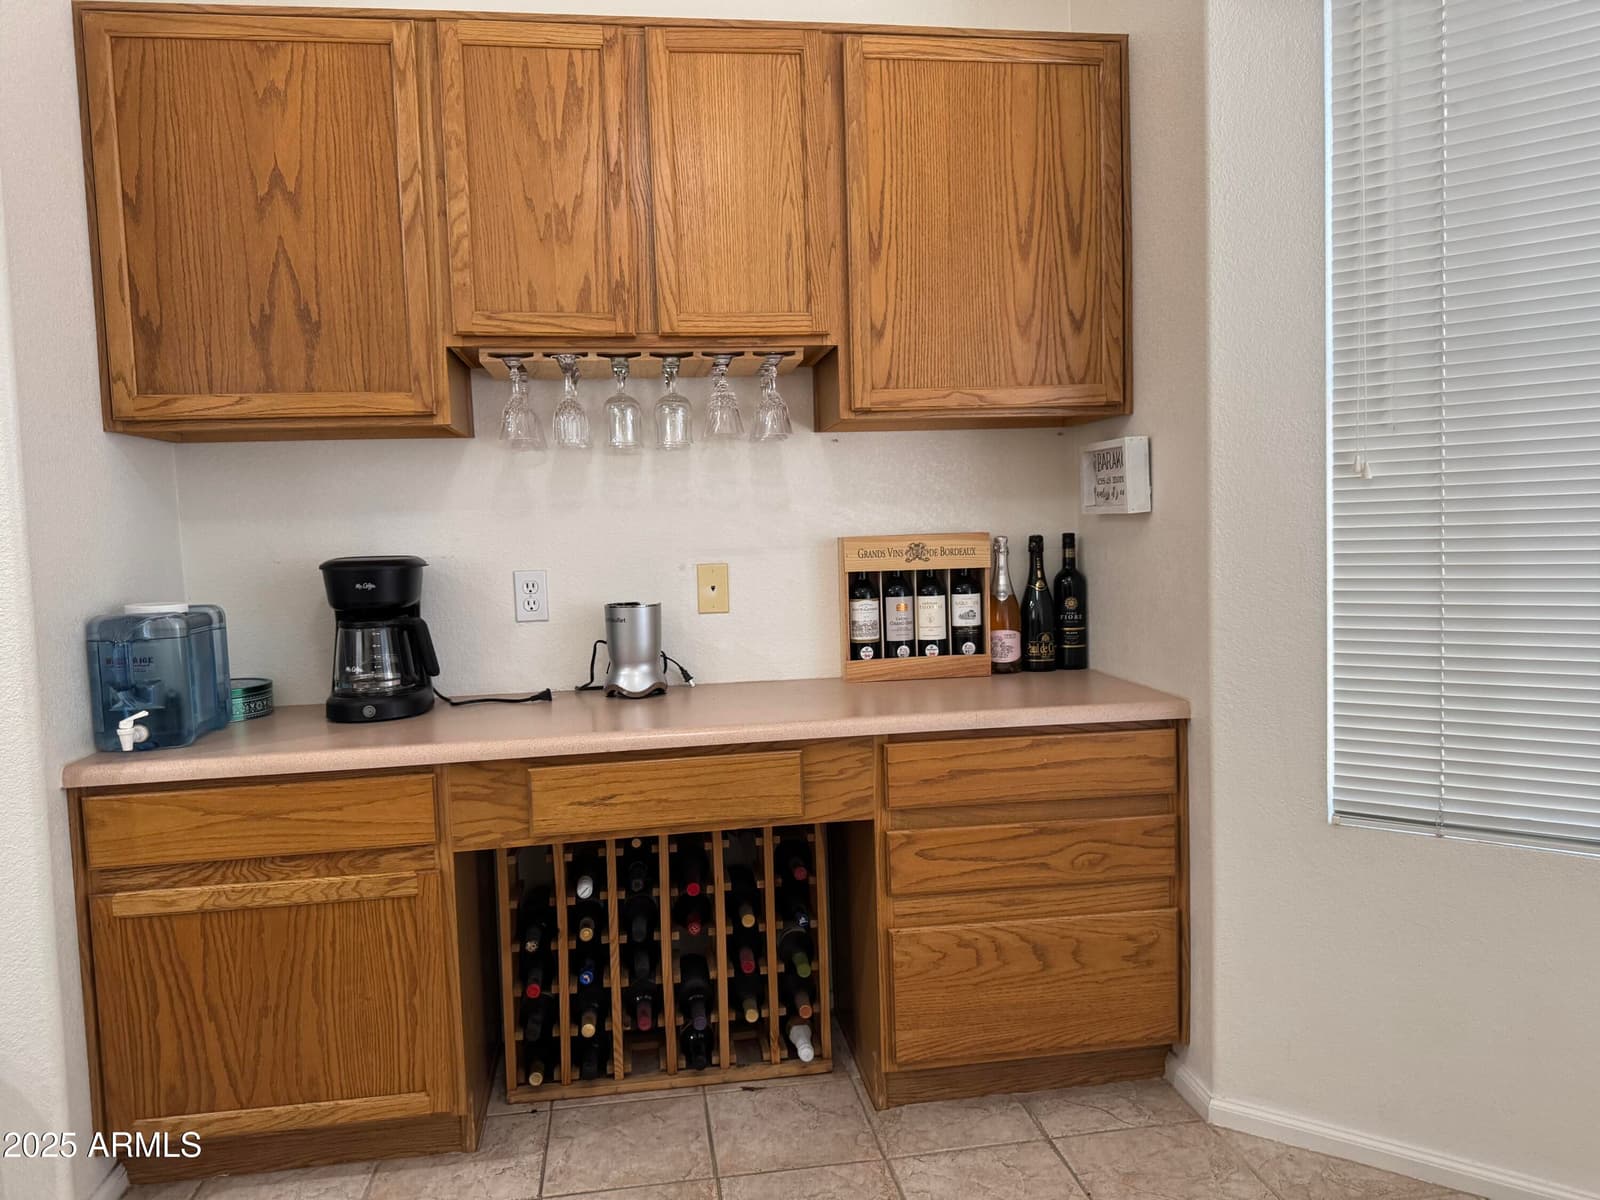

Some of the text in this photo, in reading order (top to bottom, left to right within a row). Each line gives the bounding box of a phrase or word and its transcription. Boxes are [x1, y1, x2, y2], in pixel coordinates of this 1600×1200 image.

[857, 546, 976, 559] GRANDS VINS DE BORDEAUX
